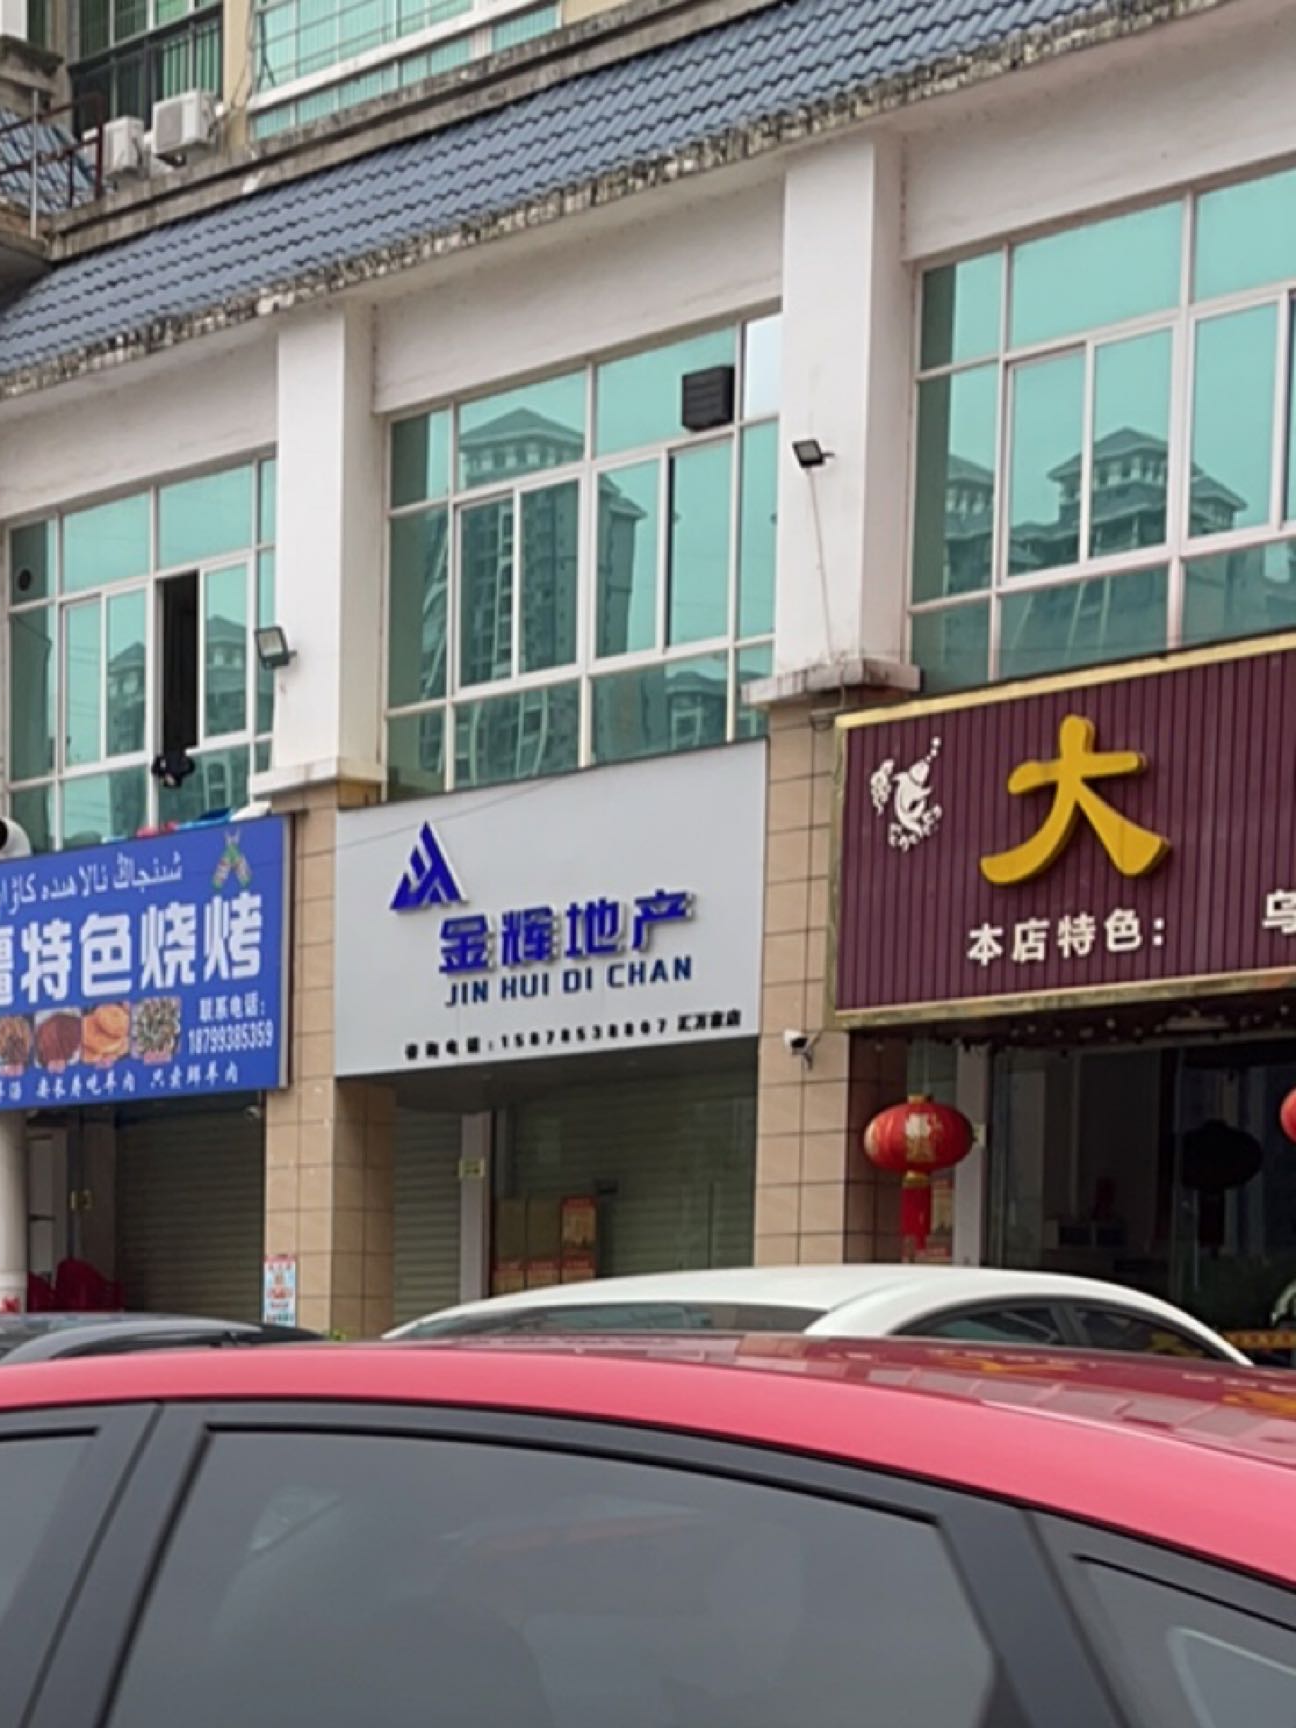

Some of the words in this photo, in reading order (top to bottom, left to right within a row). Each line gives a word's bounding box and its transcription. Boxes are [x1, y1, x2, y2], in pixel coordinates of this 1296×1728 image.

[980, 714, 1172, 884] 大
[439, 889, 693, 974] 金辉地产
[445, 978, 489, 1007] JIN
[500, 972, 550, 1001] HUI
[562, 966, 593, 994] DI
[607, 956, 693, 990] CHAN
